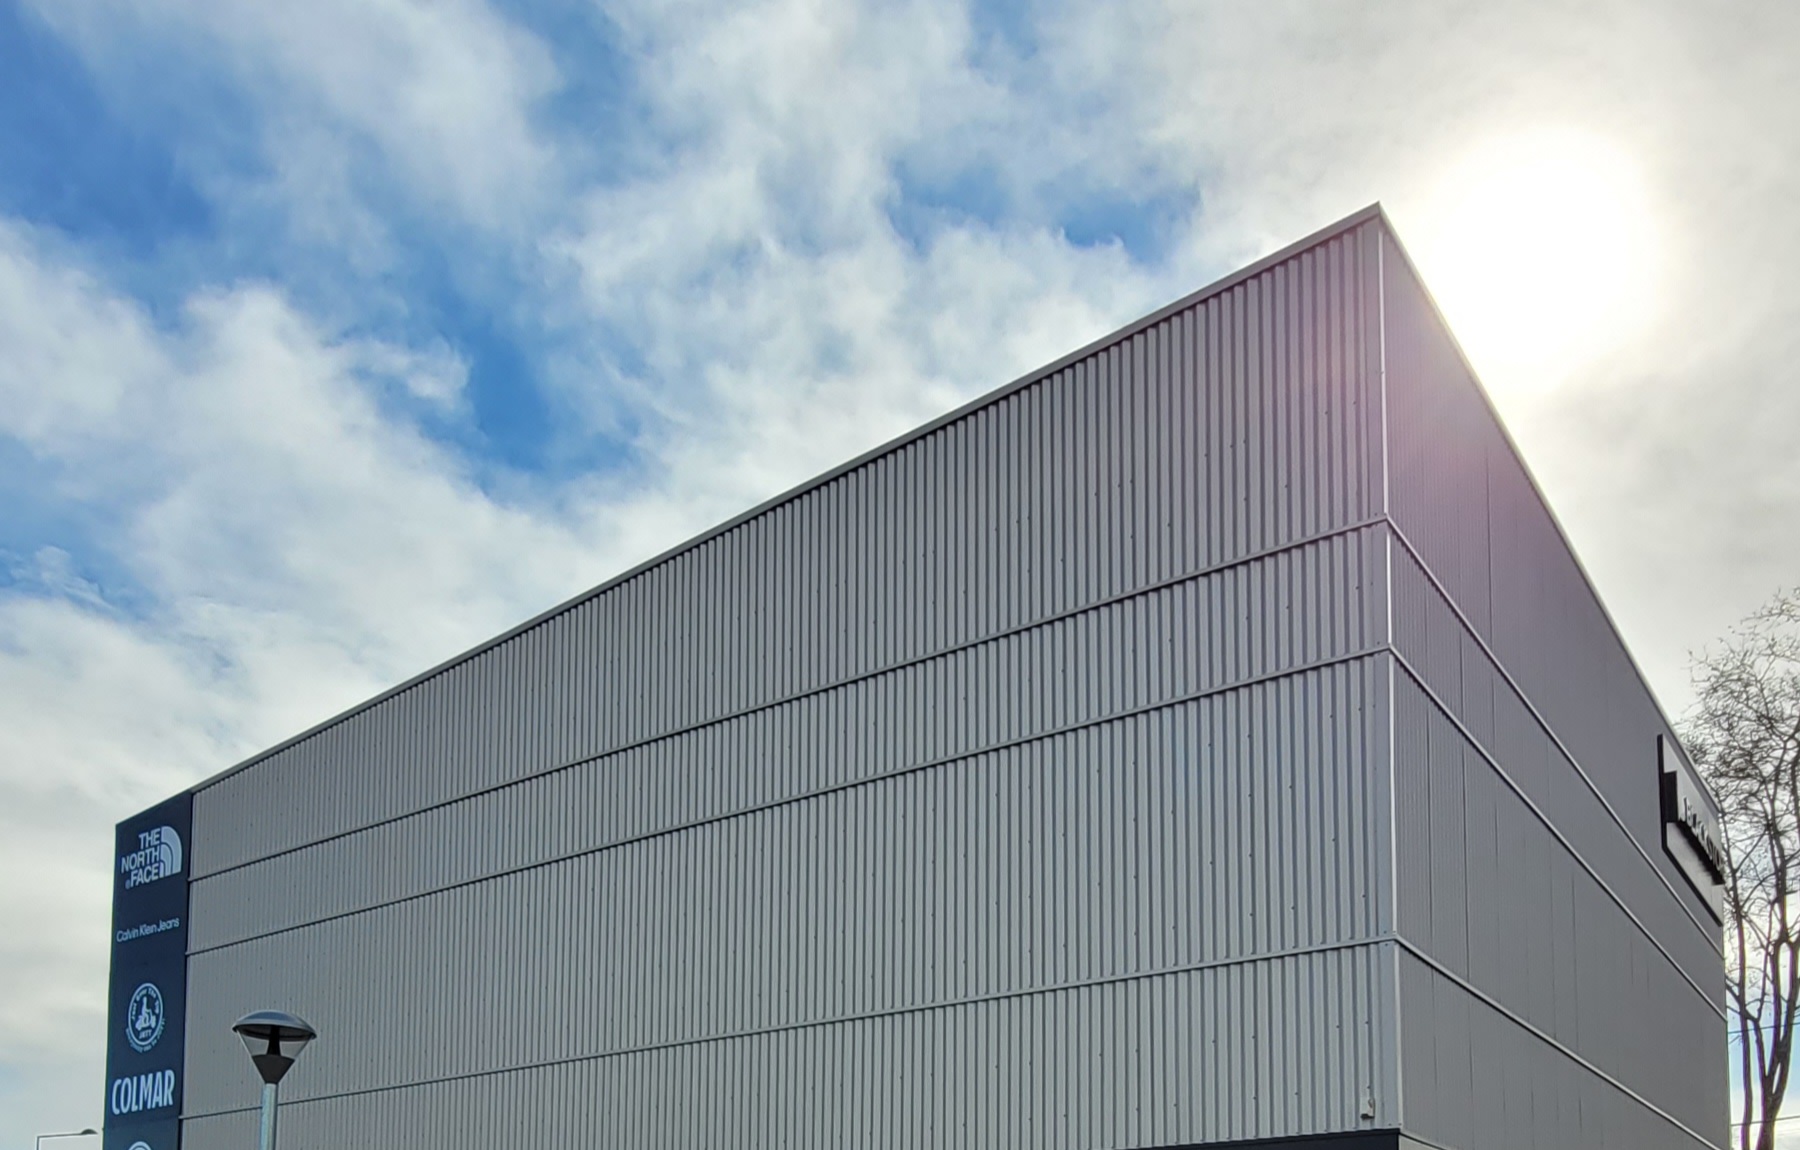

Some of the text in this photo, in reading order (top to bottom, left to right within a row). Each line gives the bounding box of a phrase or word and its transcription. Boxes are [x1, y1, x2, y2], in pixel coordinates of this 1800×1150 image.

[138, 828, 160, 850] THE
[121, 845, 160, 873] NORTH
[130, 863, 159, 887] FACE
[116, 927, 139, 942] Calvin
[158, 918, 180, 932] Jeans
[112, 1069, 175, 1115] COLMAR
